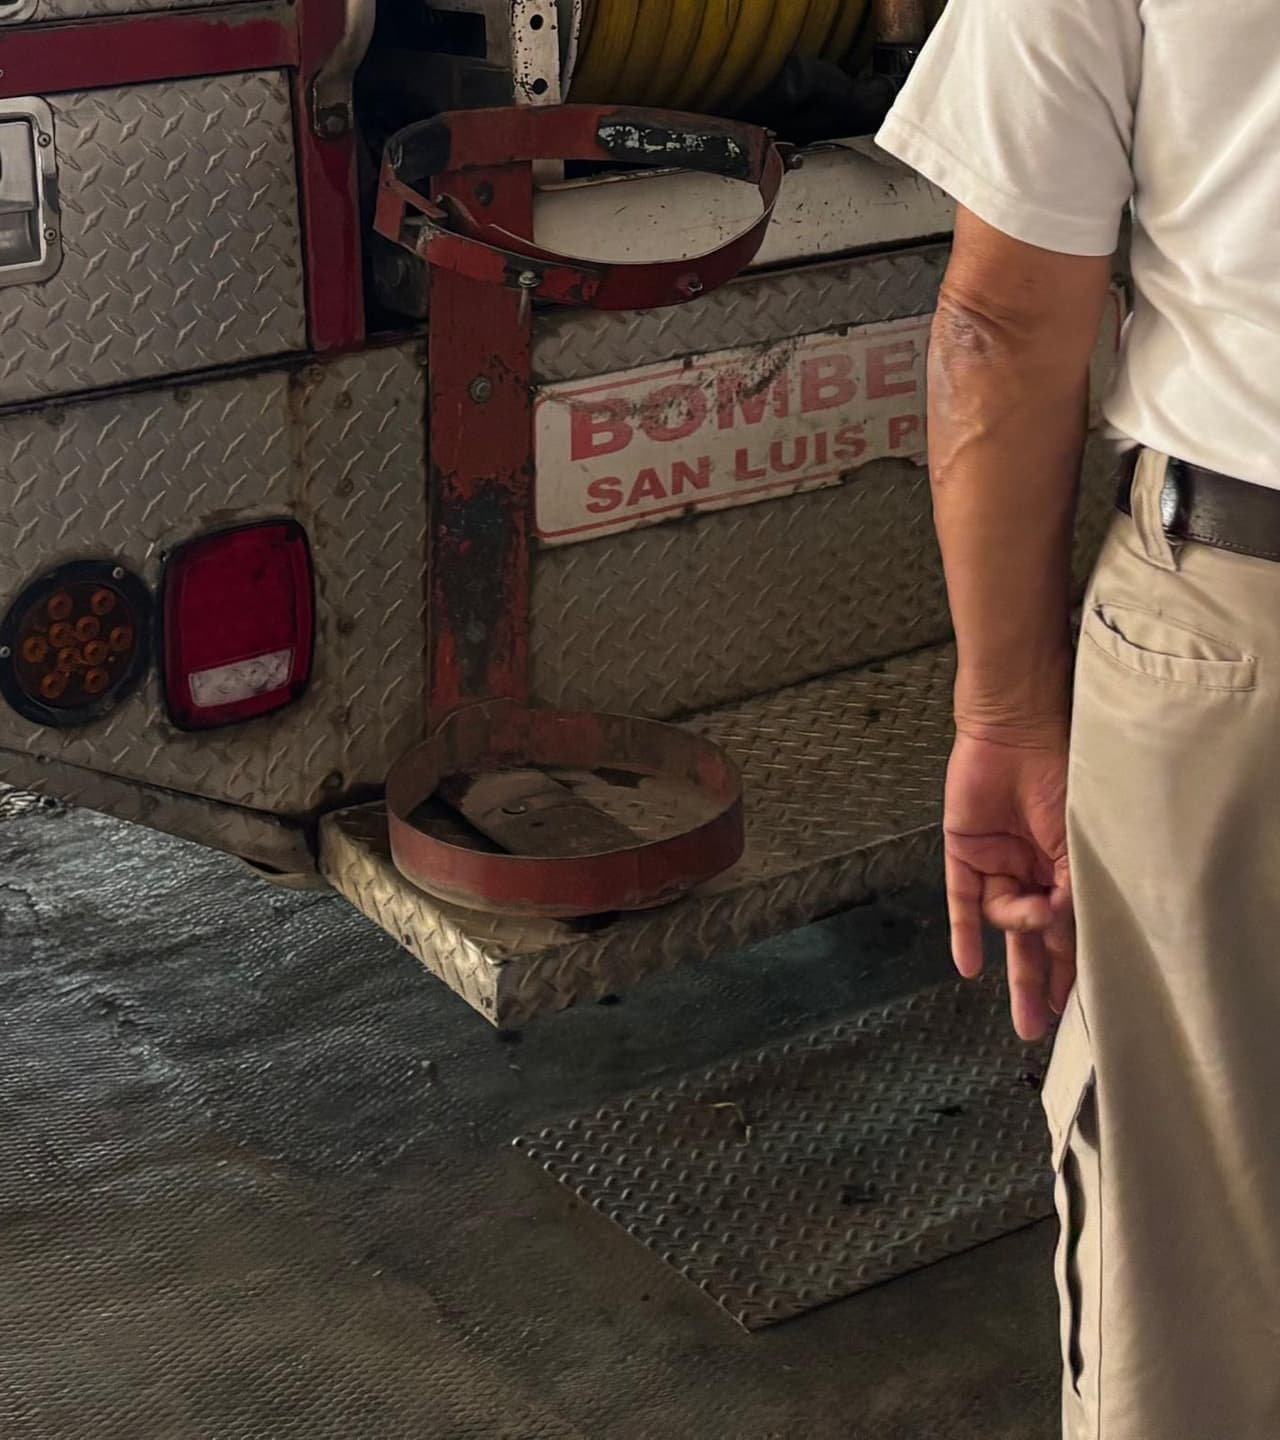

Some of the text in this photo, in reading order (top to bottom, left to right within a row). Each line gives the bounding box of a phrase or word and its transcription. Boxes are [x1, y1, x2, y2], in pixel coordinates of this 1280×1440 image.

[570, 339, 920, 462] BOMBE
[586, 456, 711, 514] SAN
[734, 425, 867, 482] LUIS
